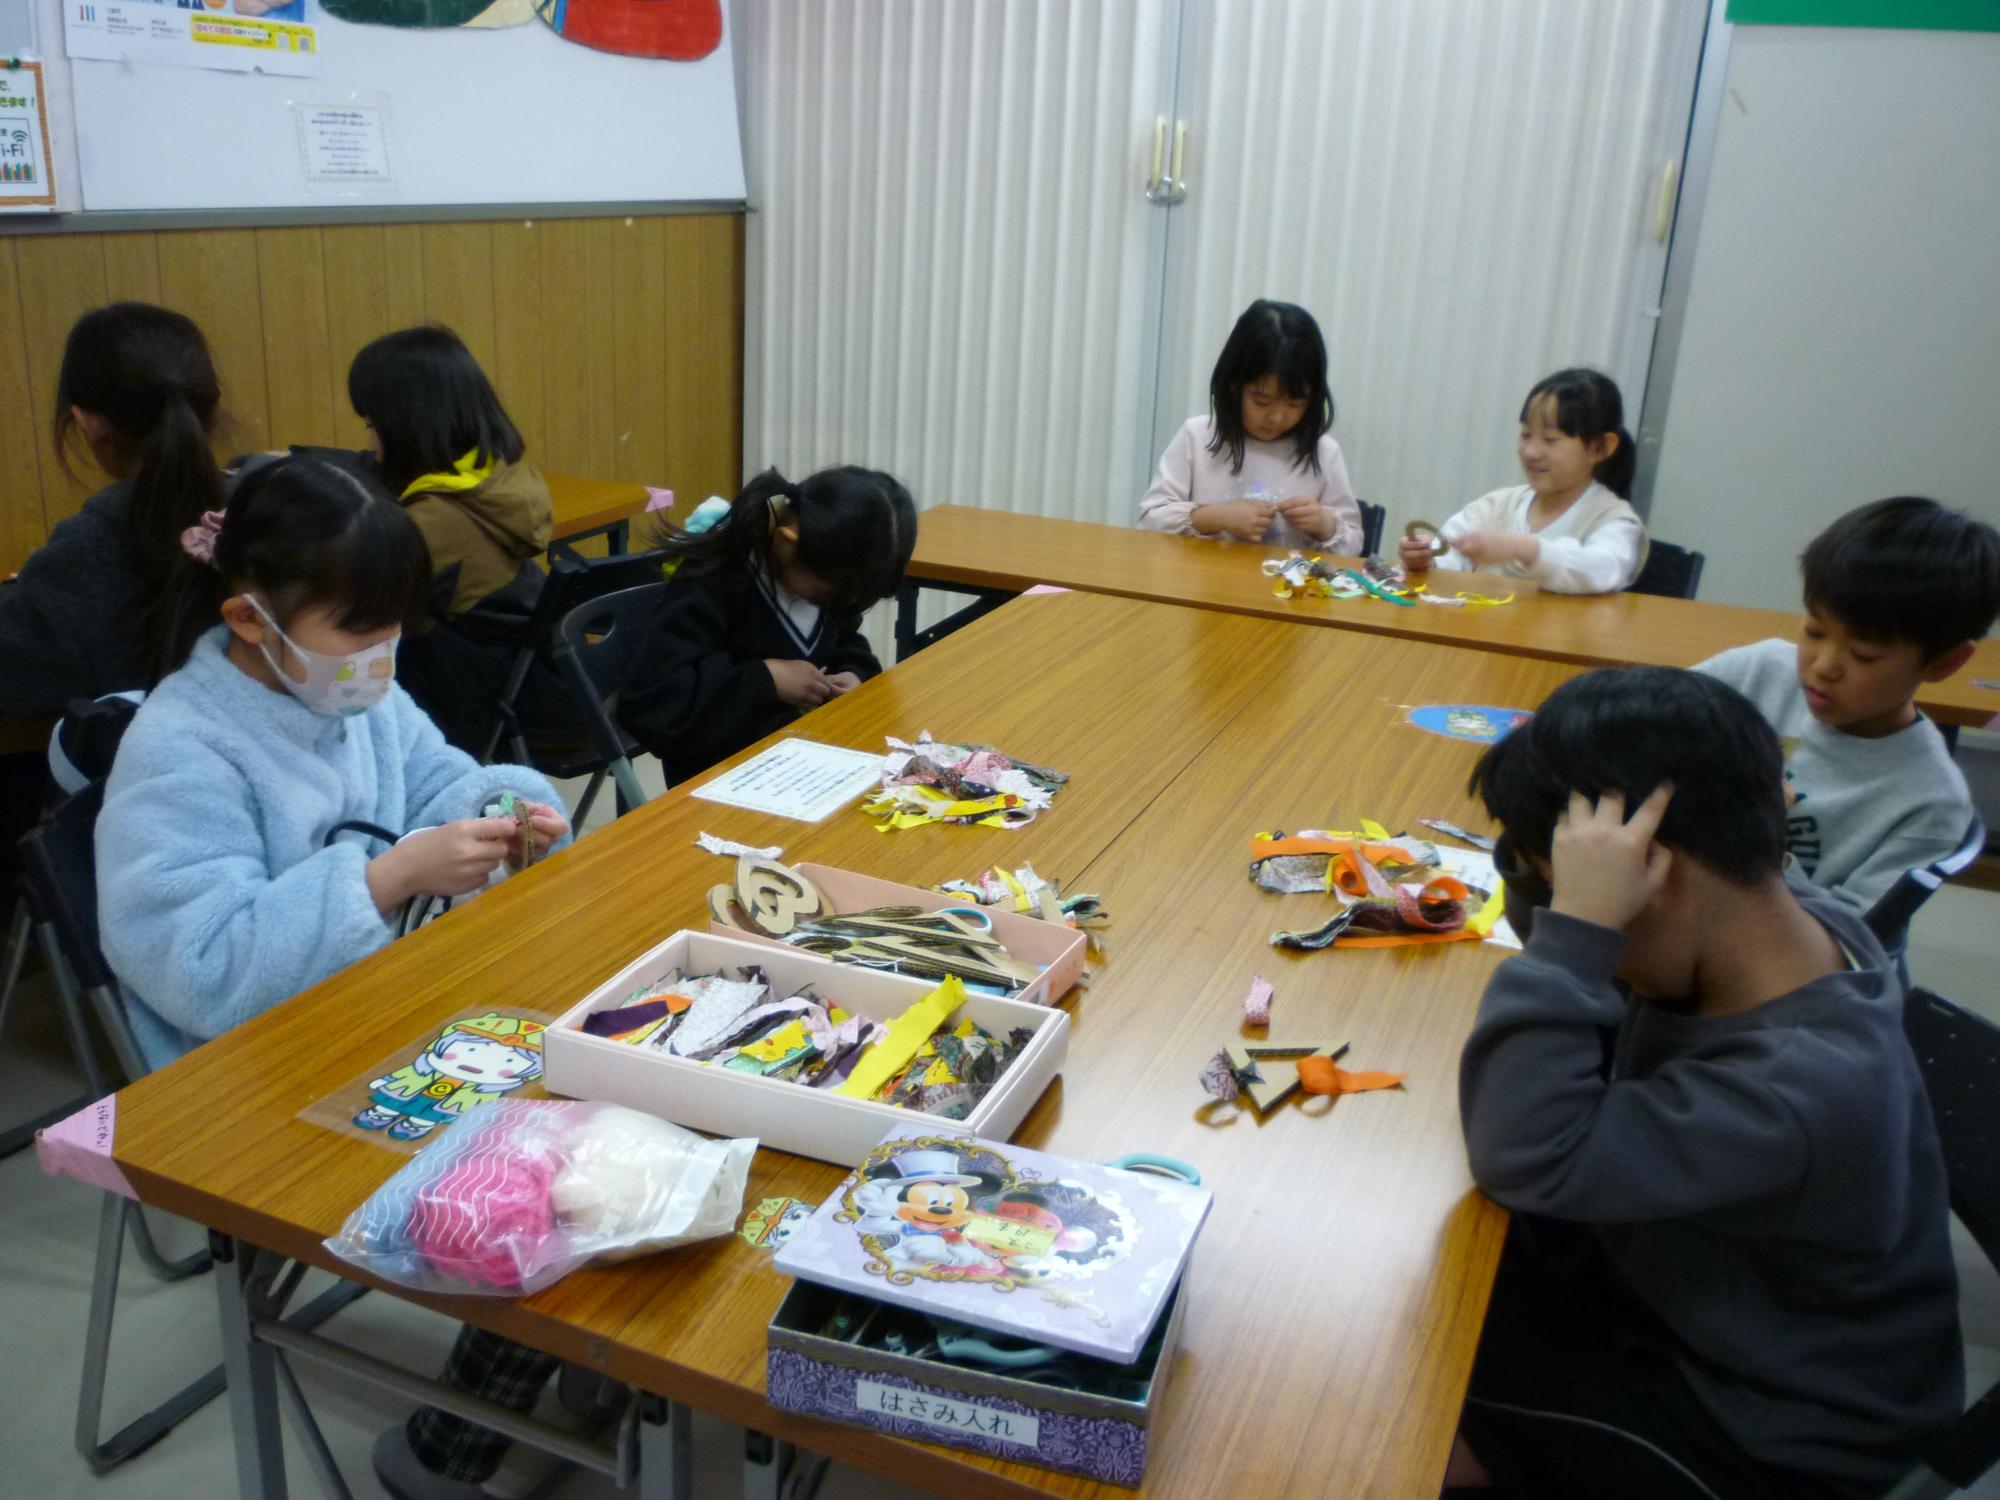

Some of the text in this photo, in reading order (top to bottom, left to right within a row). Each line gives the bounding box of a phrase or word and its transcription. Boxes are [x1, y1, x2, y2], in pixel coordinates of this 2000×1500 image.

[0, 142, 25, 157] i-Fi
[880, 1390, 1014, 1437] はさみ入れ
